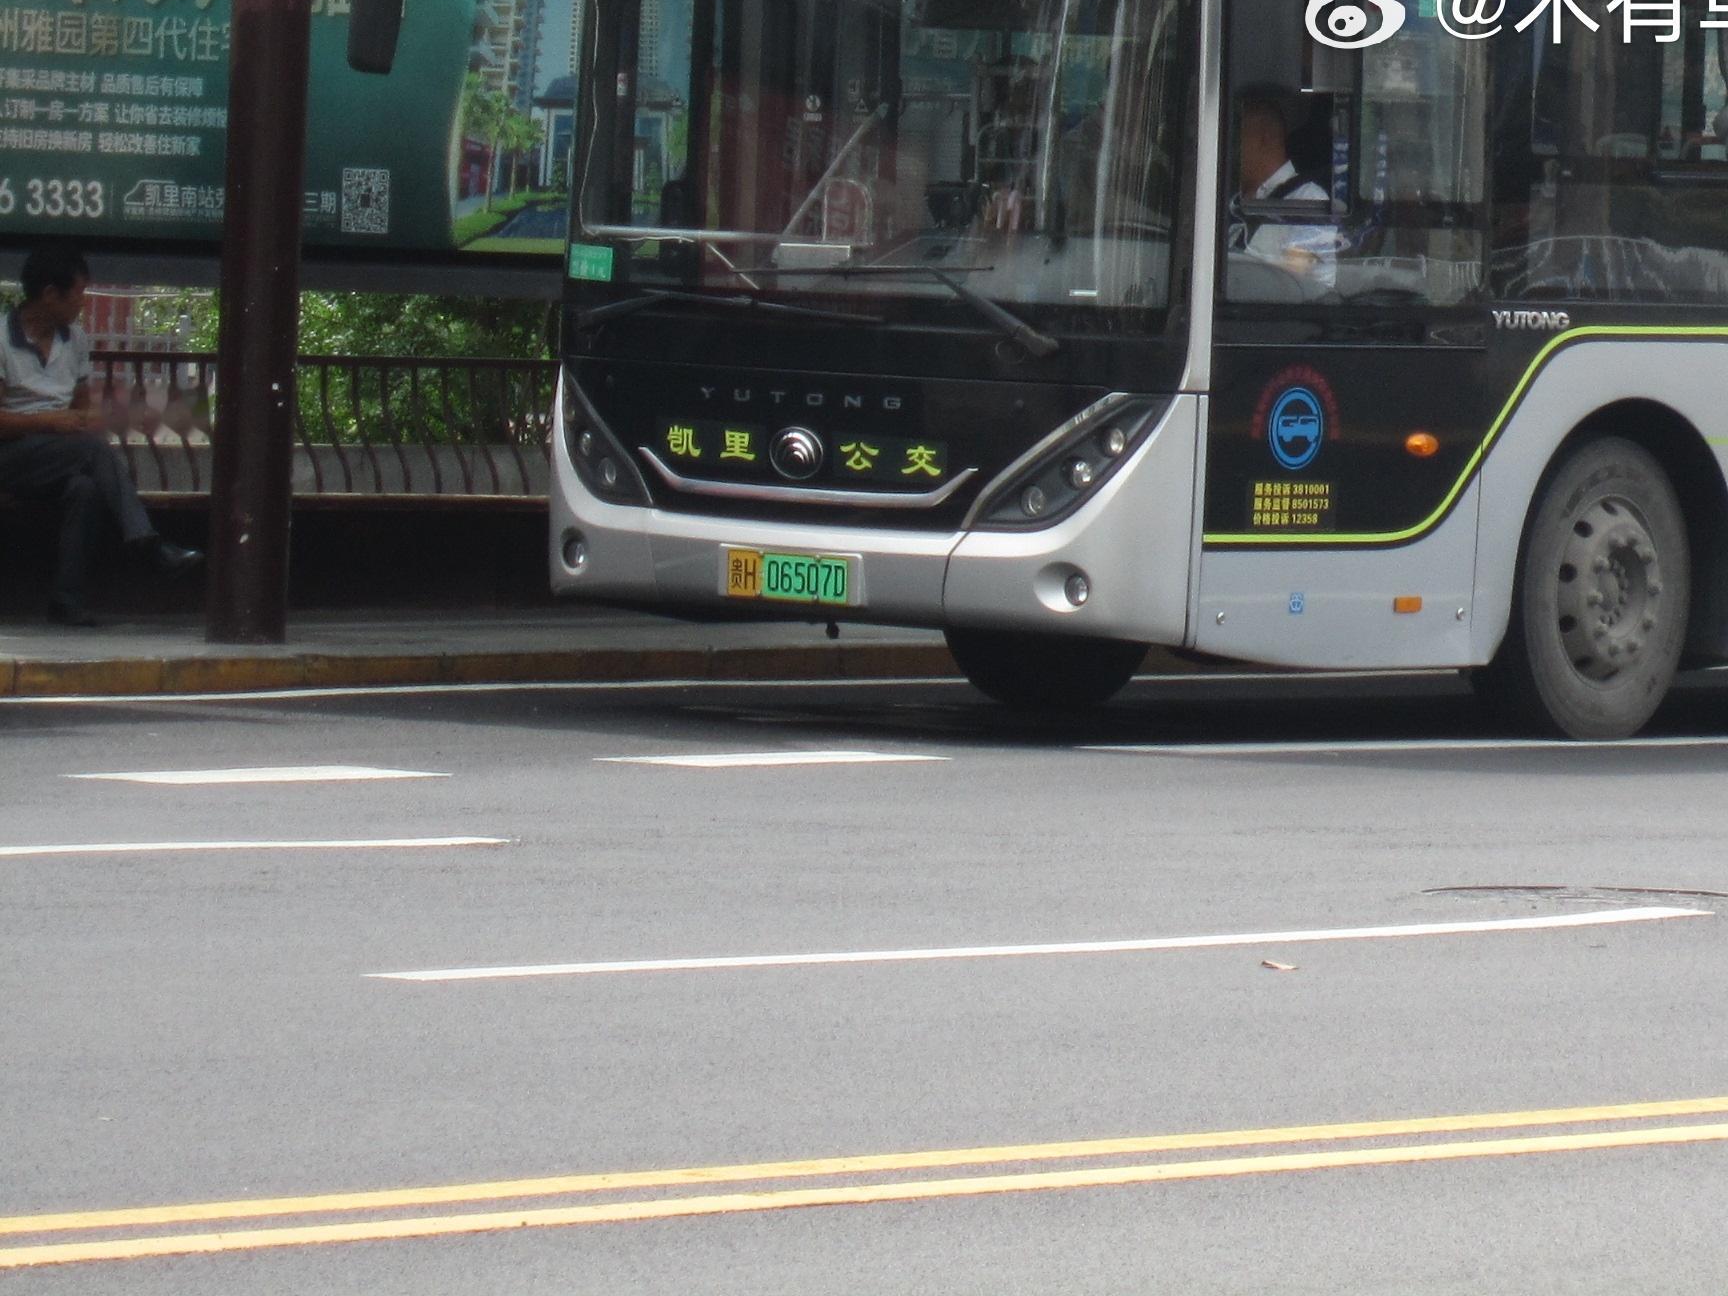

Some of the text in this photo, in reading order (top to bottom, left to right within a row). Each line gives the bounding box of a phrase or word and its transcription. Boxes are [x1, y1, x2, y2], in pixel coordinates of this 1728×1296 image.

[0, 98, 109, 124] 订制一房一方案
[0, 127, 93, 153] 持旧房换新房
[26, 178, 104, 218] 3333
[1491, 310, 1570, 330] YUTONG
[700, 386, 903, 410] YUTONG
